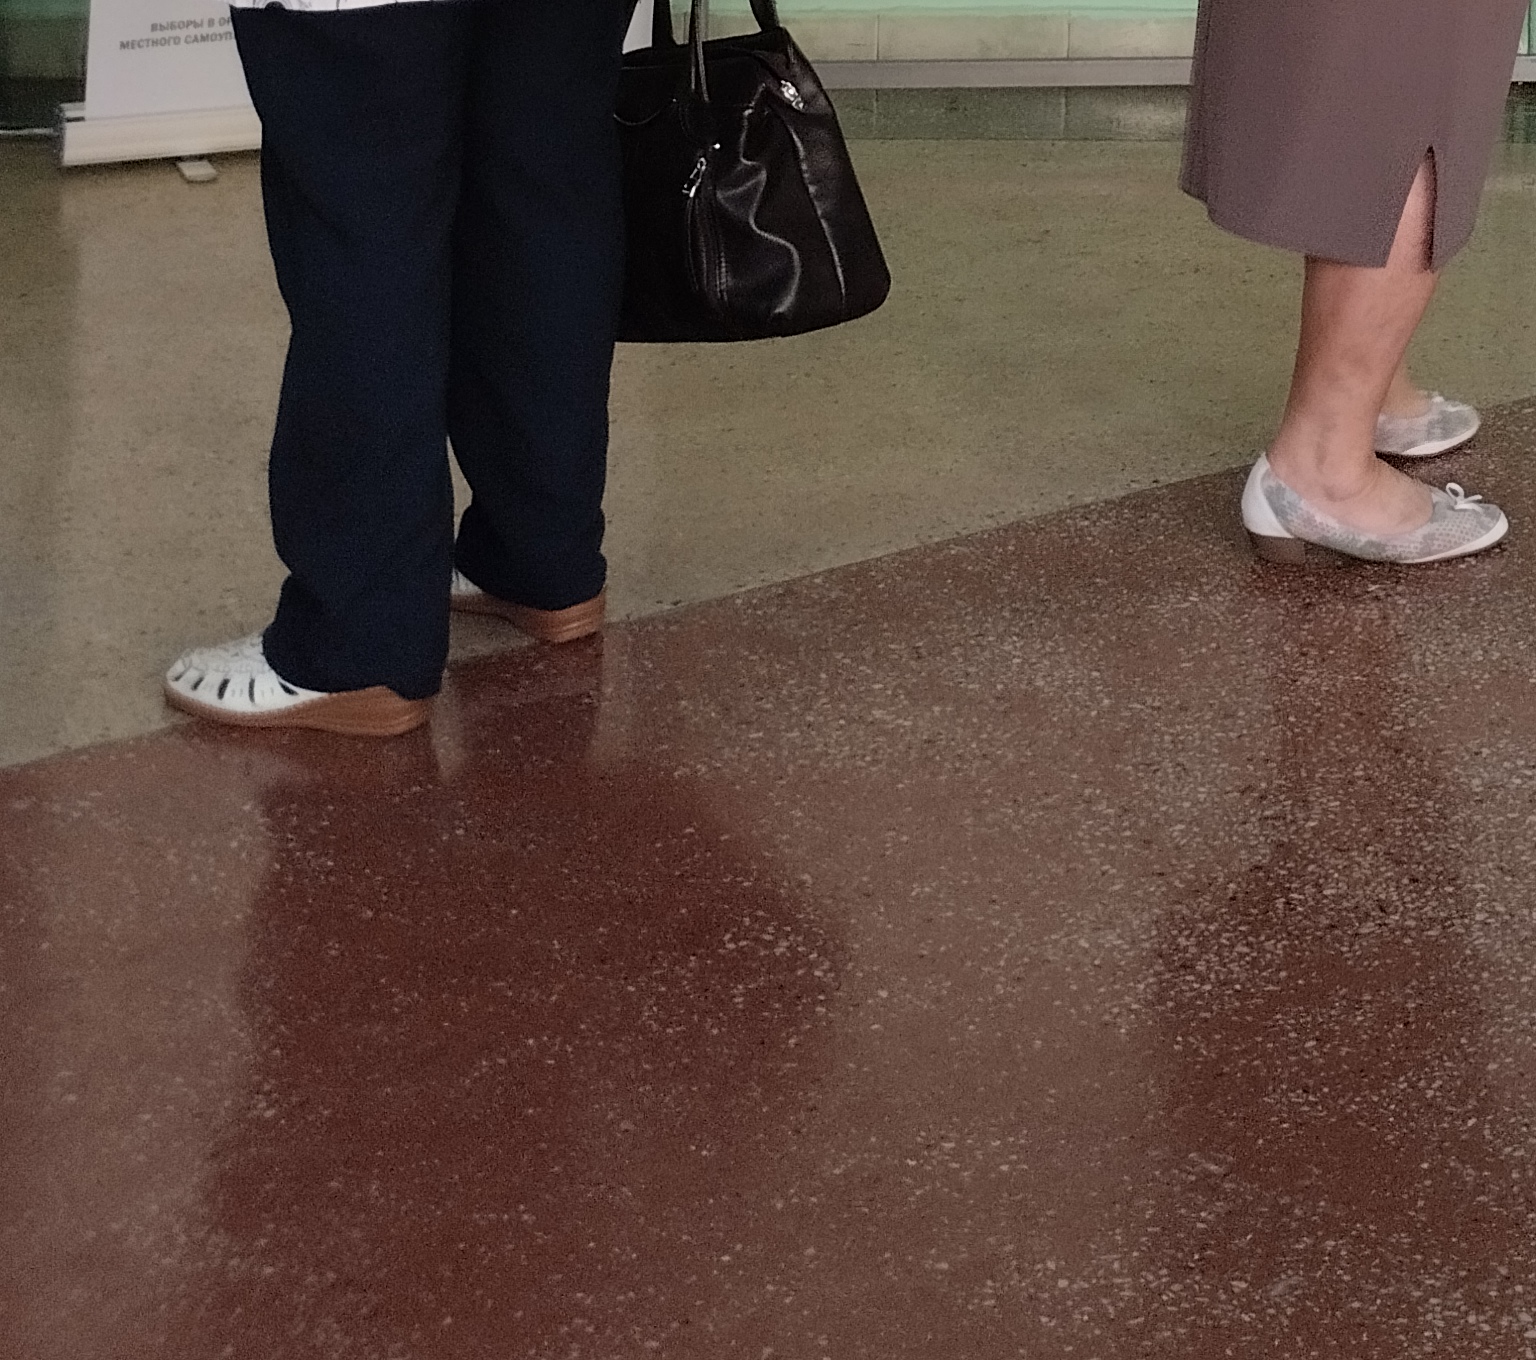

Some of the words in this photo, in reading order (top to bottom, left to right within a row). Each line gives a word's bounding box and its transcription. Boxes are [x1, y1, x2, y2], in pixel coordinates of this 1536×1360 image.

[150, 18, 204, 32] ВЫБОРЫ
[208, 17, 215, 28] В
[119, 36, 181, 50] МЕСТНОГО
[184, 31, 234, 45] САМОУП
